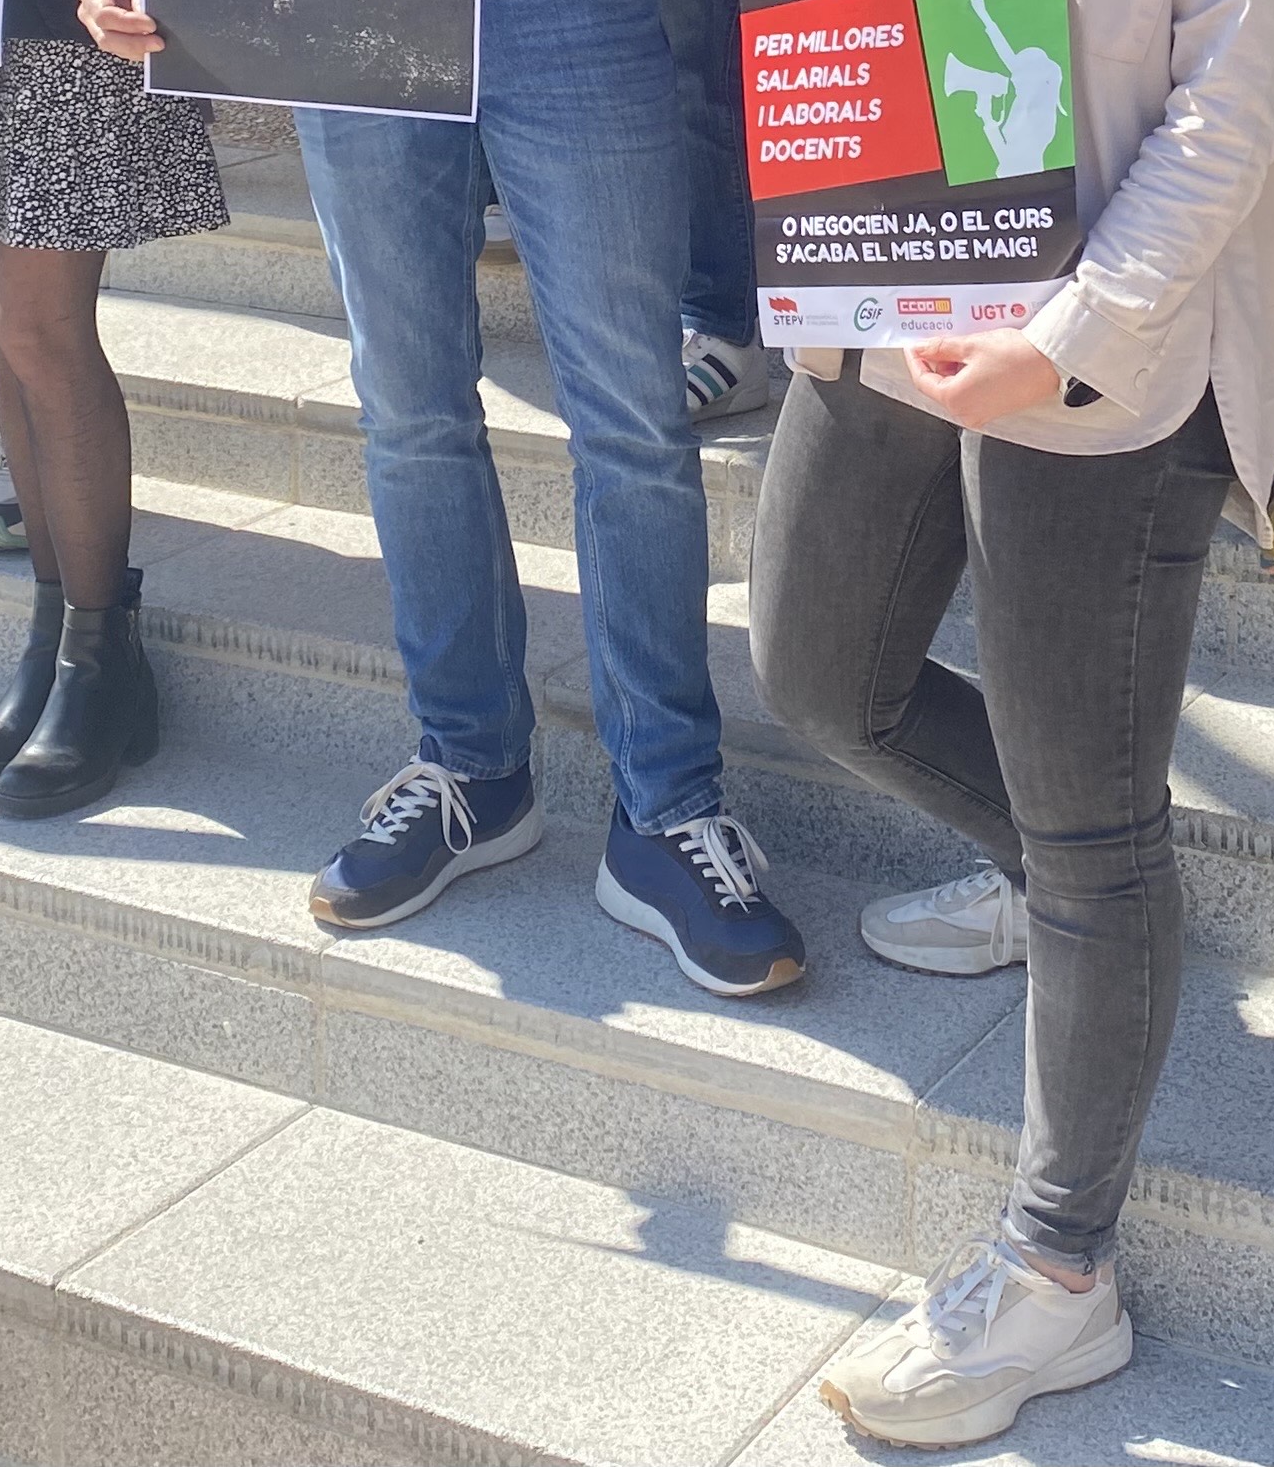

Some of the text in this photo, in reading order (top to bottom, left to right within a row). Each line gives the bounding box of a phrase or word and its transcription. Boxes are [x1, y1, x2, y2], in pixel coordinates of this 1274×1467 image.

[754, 23, 905, 58] PER MILLORES
[755, 62, 871, 92] SALARIALS
[757, 98, 882, 127] I LABORALS
[760, 135, 862, 162] DOCENTS
[782, 207, 1054, 237] O NEGOCIEN JA, O EL CURS
[776, 236, 1038, 264] S'ACABA EL MES DE MAIG!
[773, 315, 804, 326] STEPV
[859, 308, 884, 320] CSIF
[901, 318, 953, 331] educació
[971, 304, 1007, 321] UGT
